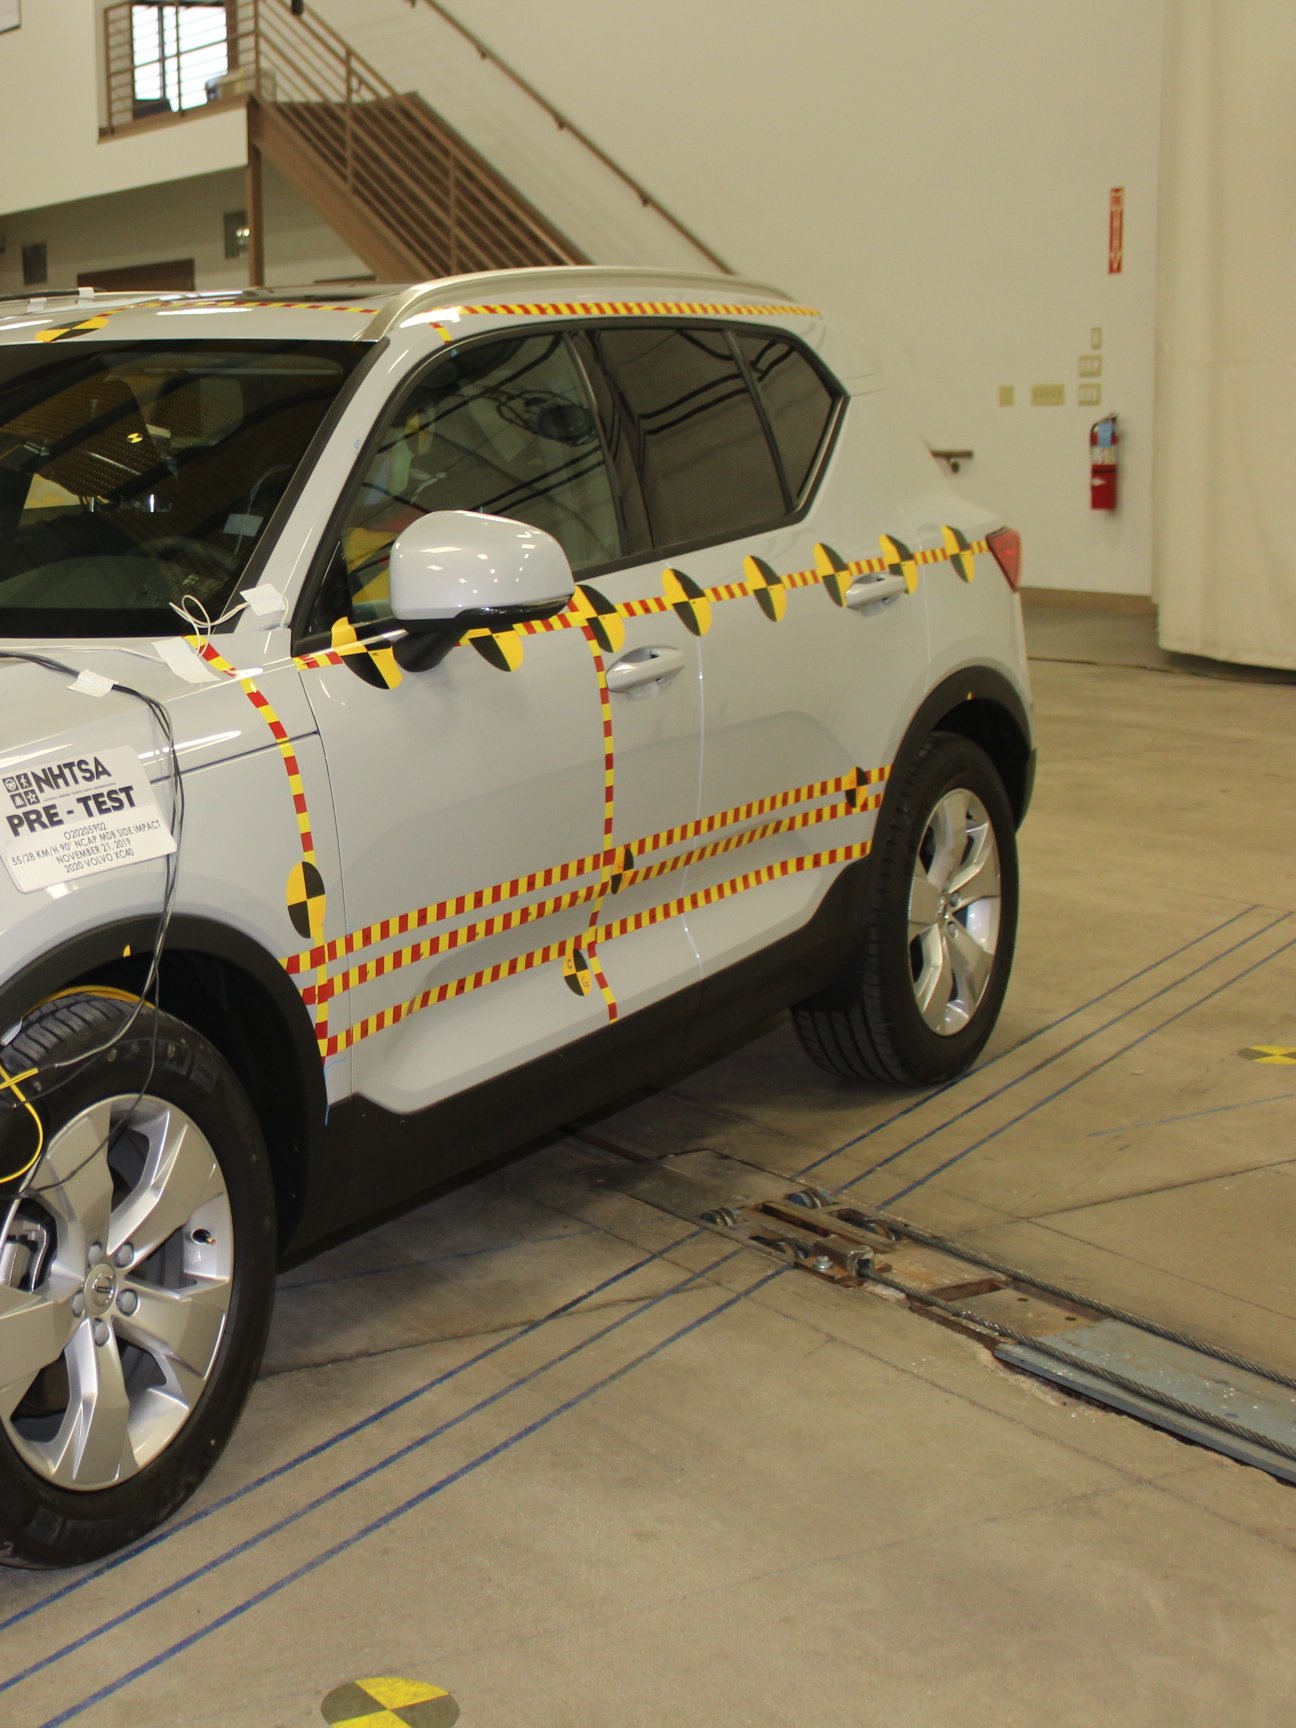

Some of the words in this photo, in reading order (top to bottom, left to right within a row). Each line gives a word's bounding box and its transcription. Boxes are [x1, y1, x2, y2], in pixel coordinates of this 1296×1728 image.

[31, 756, 112, 793] NHTSA
[6, 804, 64, 837] PRE
[76, 786, 136, 818] TEST
[11, 853, 36, 867] 55/28
[37, 846, 60, 862] KM/H
[74, 836, 98, 851] NCAP
[99, 830, 117, 843] MDB
[116, 826, 134, 839] SIDE
[133, 820, 162, 836] IMPACT
[56, 847, 101, 865] NOVEMBER
[114, 838, 132, 850] 2019
[64, 860, 85, 874] 2020
[84, 854, 114, 869] VOLVO
[114, 848, 135, 862] XC40
